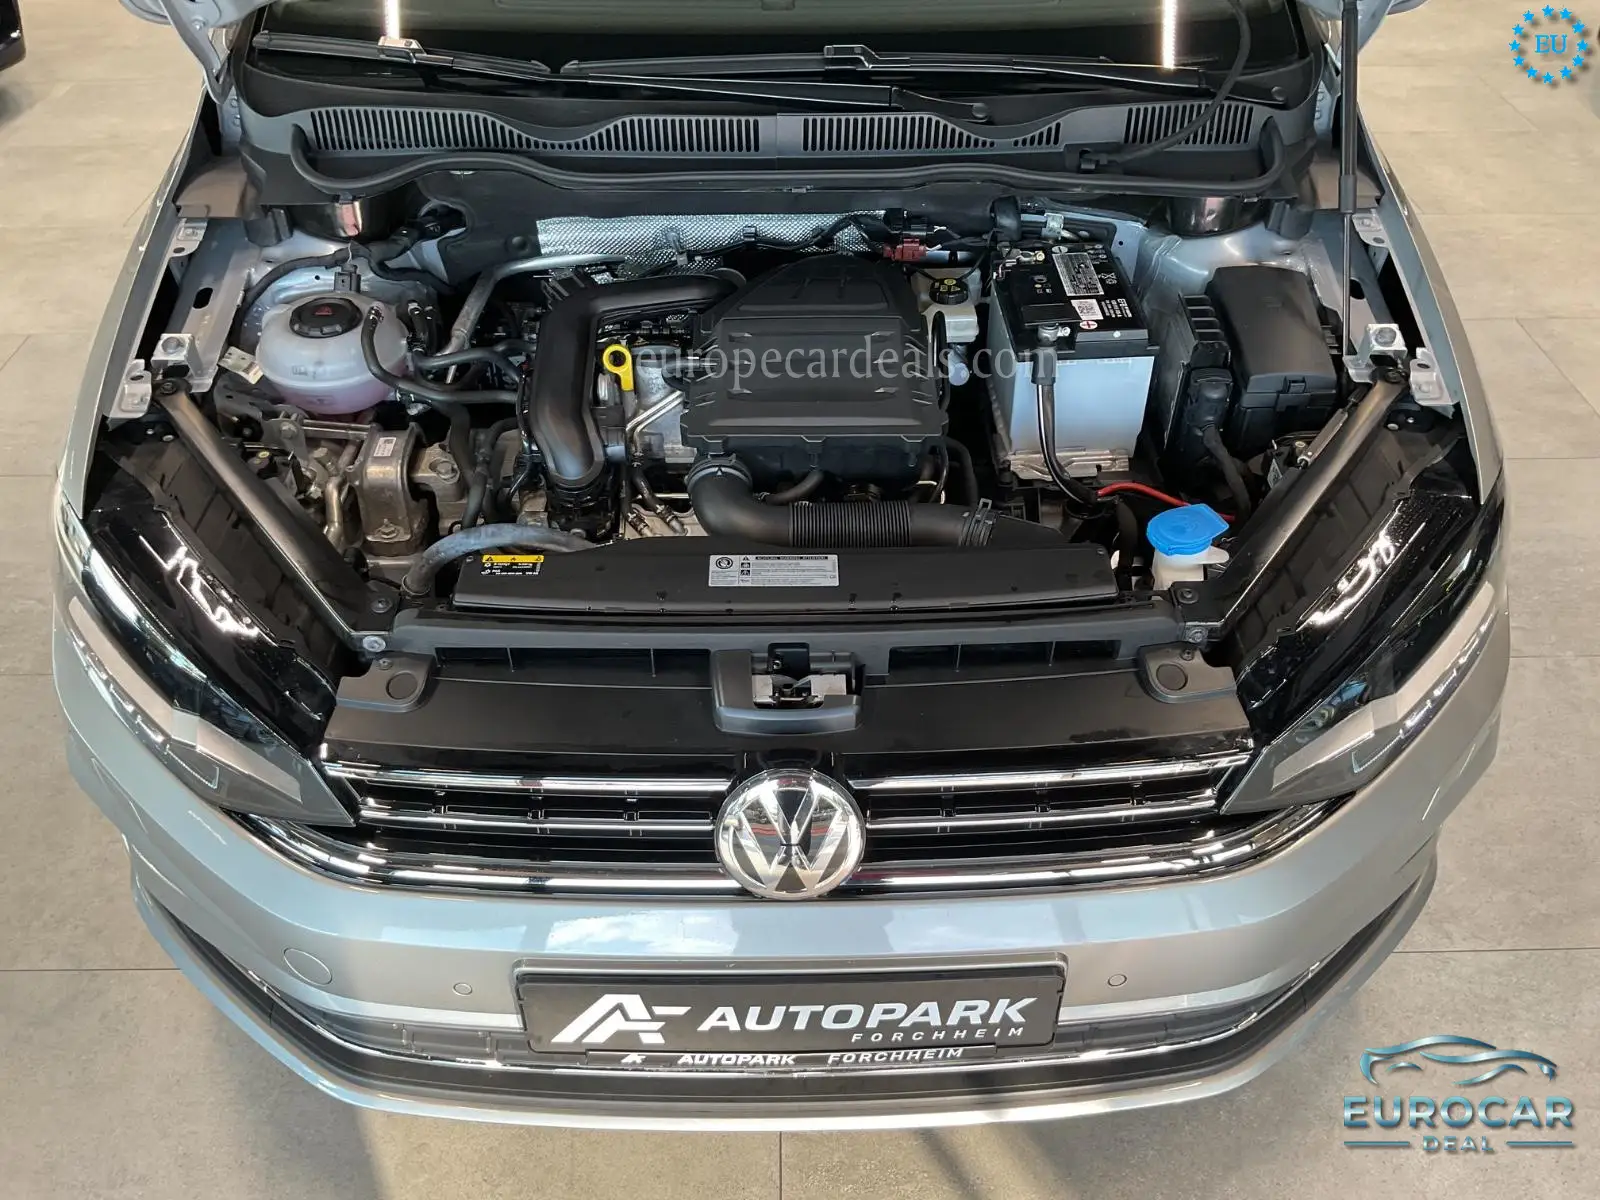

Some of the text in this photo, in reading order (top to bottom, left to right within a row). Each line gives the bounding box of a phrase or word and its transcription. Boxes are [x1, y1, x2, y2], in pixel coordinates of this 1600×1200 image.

[697, 998, 1038, 1031] AUTOPARK
[851, 1027, 1024, 1043] FORCHHEIM
[677, 1054, 796, 1066] AUTOPARK
[827, 1048, 964, 1064] FORCHHEIM
